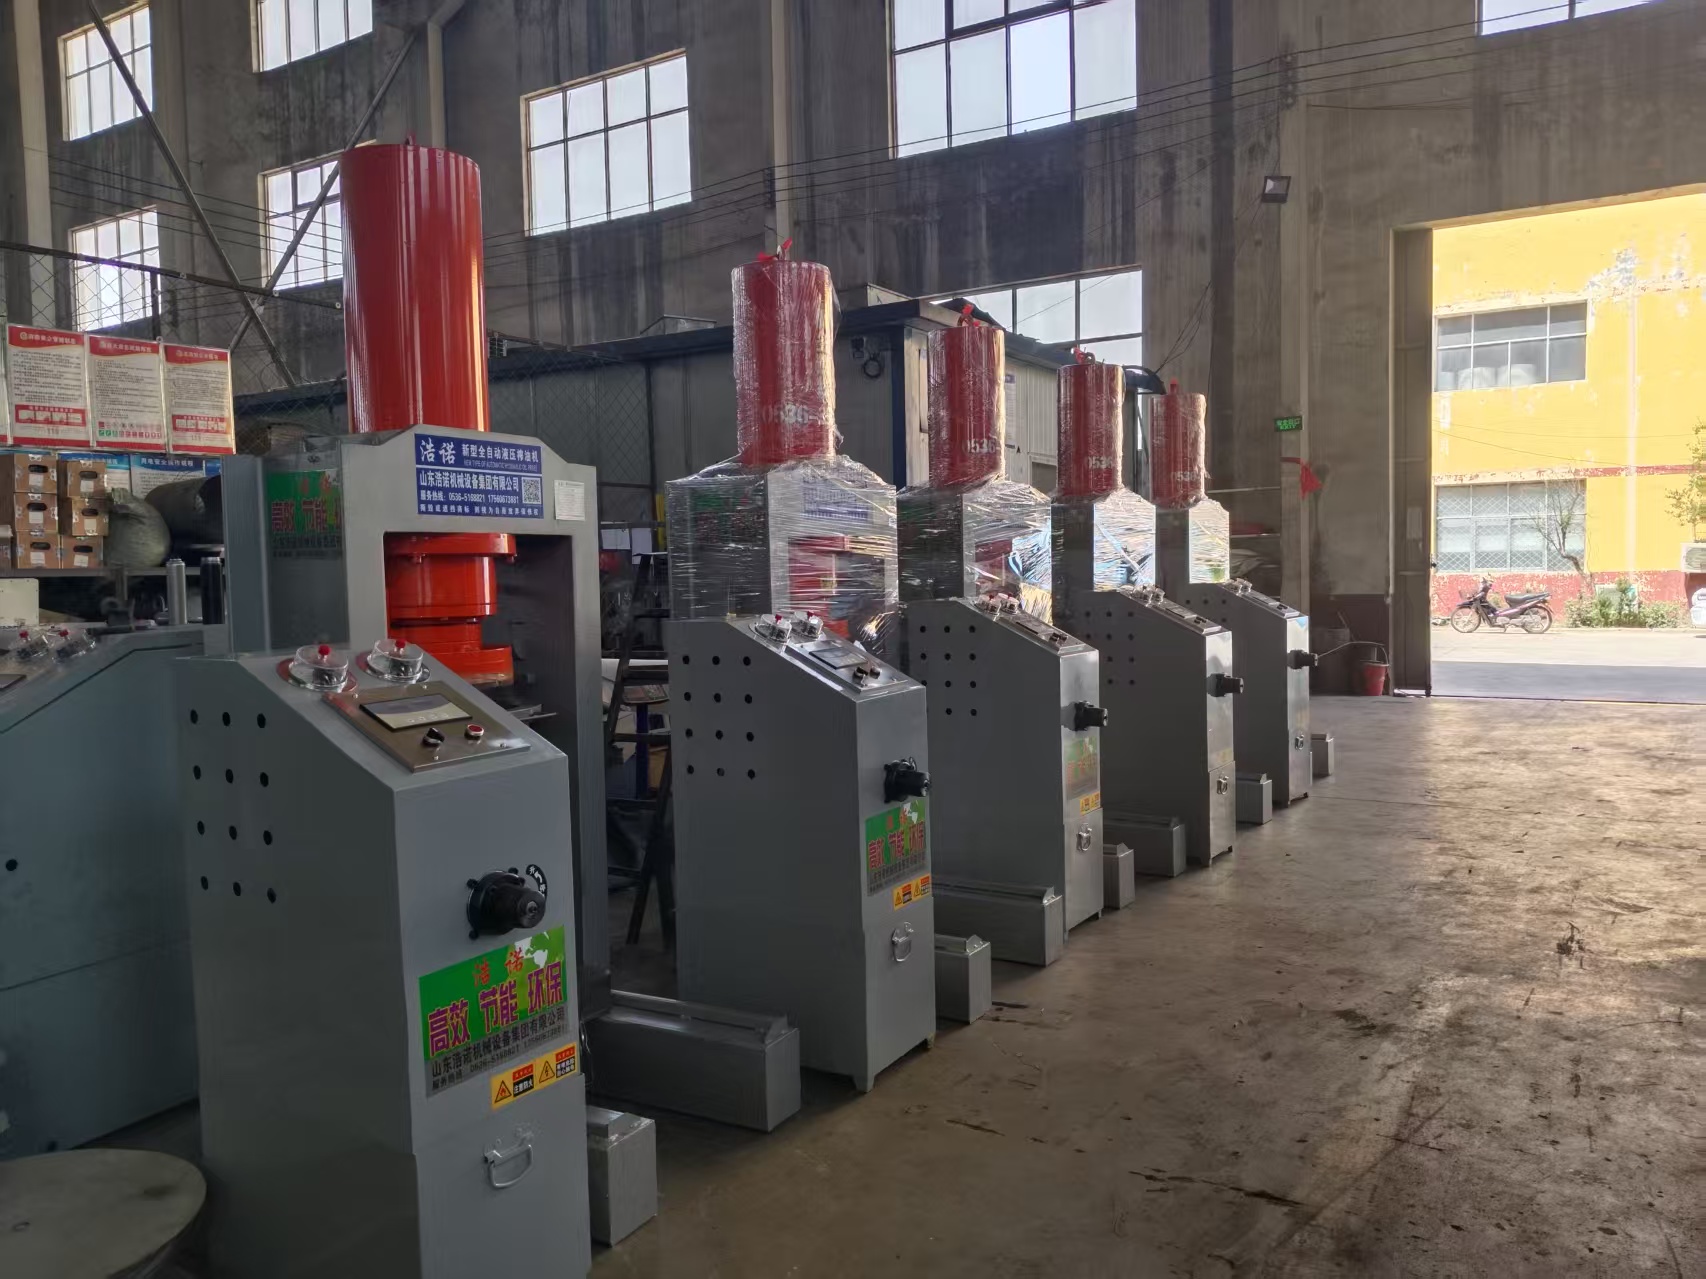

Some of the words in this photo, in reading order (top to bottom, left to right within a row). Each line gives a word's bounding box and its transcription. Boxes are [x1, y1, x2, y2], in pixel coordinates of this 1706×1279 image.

[140, 457, 194, 467] 用电安全操作规程
[420, 437, 457, 465] 浩诺
[462, 444, 539, 463] 新型全自动液压榨油机
[420, 472, 519, 493] 山东浩诺机械设备集团有限公司
[529, 865, 535, 875] 升
[472, 947, 524, 988] 浩诺
[428, 998, 471, 1056] 高效
[479, 978, 519, 1033] 节能
[527, 960, 563, 1015] 环保
[432, 1008, 566, 1077] 山东浩诺机械设备集团有限公司
[513, 1078, 533, 1094] 注意防火
